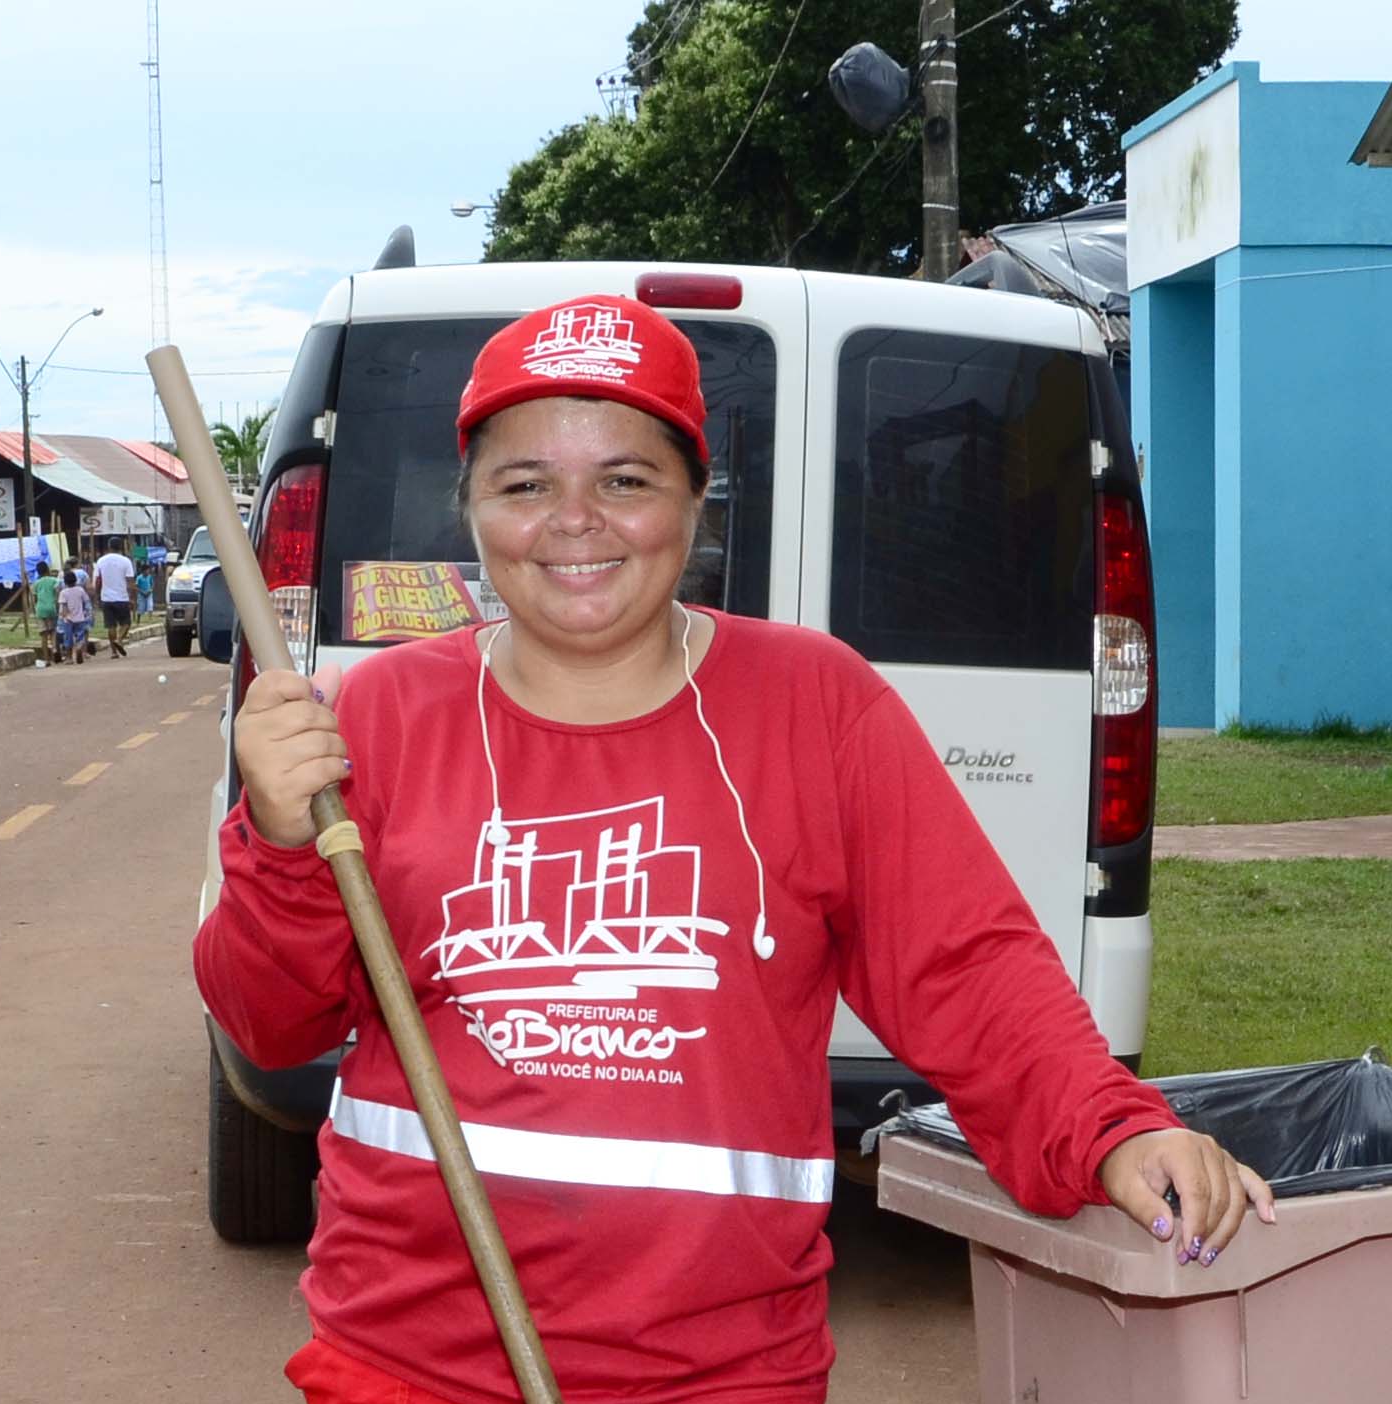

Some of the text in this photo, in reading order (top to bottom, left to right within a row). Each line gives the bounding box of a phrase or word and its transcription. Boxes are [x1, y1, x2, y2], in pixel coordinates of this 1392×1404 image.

[351, 564, 452, 593] DENGUE
[353, 591, 370, 618] A
[374, 580, 462, 610] GUERRA
[383, 611, 427, 629] PODE
[426, 603, 471, 630] PARAR
[965, 771, 1034, 783] ESSENCE
[545, 1003, 658, 1023] PREFEITURA DE
[513, 1060, 547, 1076] COM
[550, 1062, 591, 1080] VOCÊ
[594, 1066, 618, 1081] NO
[658, 1070, 684, 1085] DIA
